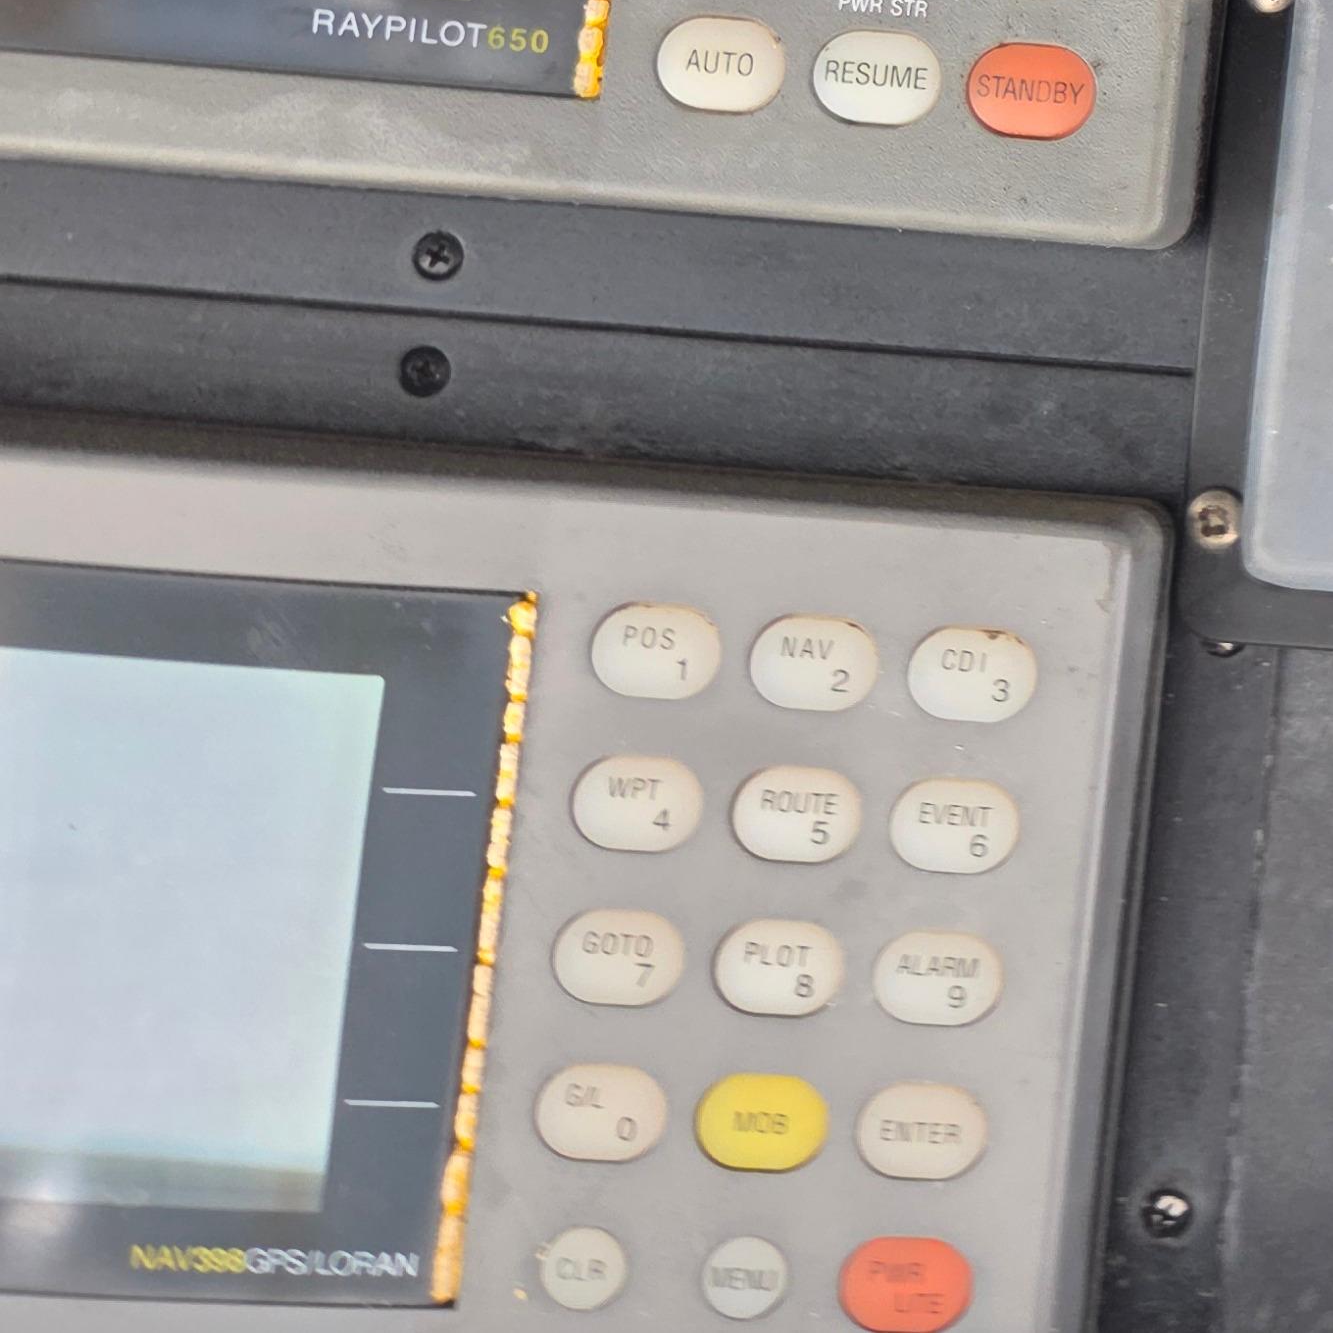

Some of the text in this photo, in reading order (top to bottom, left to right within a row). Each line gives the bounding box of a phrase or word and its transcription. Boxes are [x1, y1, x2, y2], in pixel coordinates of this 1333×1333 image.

[685, 48, 754, 77] AUTO
[825, 59, 928, 91] RESUME
[976, 74, 1086, 106] STANDBY
[623, 624, 676, 651] POS
[781, 635, 835, 661] NAV
[676, 658, 689, 682] 1
[941, 648, 988, 674] CDI
[831, 668, 849, 693] 2
[991, 678, 1010, 703] 3
[607, 776, 663, 802] WPT
[760, 789, 840, 816] ROUTE
[918, 801, 996, 829] EVENT
[652, 808, 672, 832] 4
[810, 820, 830, 846] 5
[969, 833, 989, 859] 6
[581, 930, 654, 958] GOTO
[743, 940, 813, 968] PLOT
[633, 963, 655, 989] 7
[897, 953, 982, 979] ALARM
[793, 973, 814, 999] 8
[946, 984, 968, 1009] 9
[732, 1110, 790, 1136] MOB
[878, 1118, 964, 1146] ENTER
[555, 1256, 609, 1284] CLR
[709, 1265, 780, 1293] MENU
